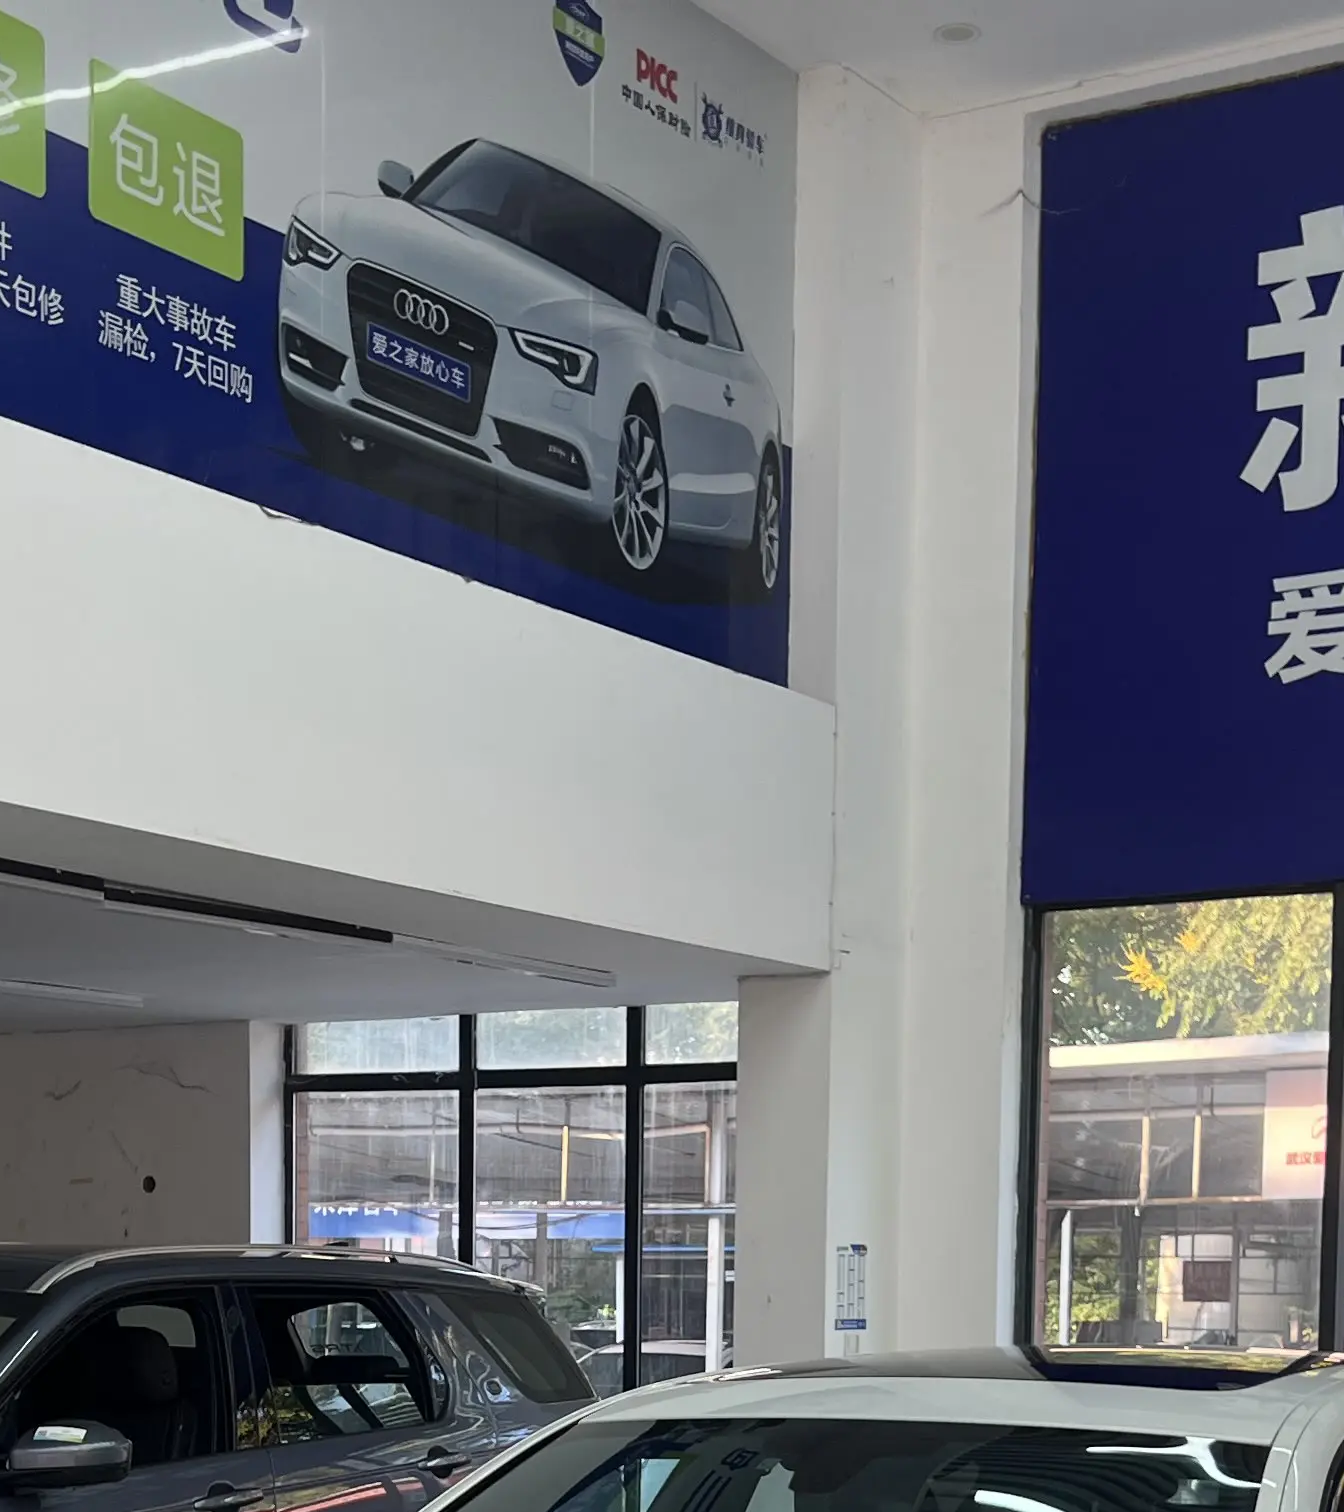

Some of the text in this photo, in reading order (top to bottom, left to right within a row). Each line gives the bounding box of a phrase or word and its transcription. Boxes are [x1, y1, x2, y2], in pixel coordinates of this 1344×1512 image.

[636, 48, 678, 104] PICC
[108, 113, 226, 237] 包退
[115, 272, 237, 352] 重大事故车
[372, 331, 466, 389] 爱之家放心车
